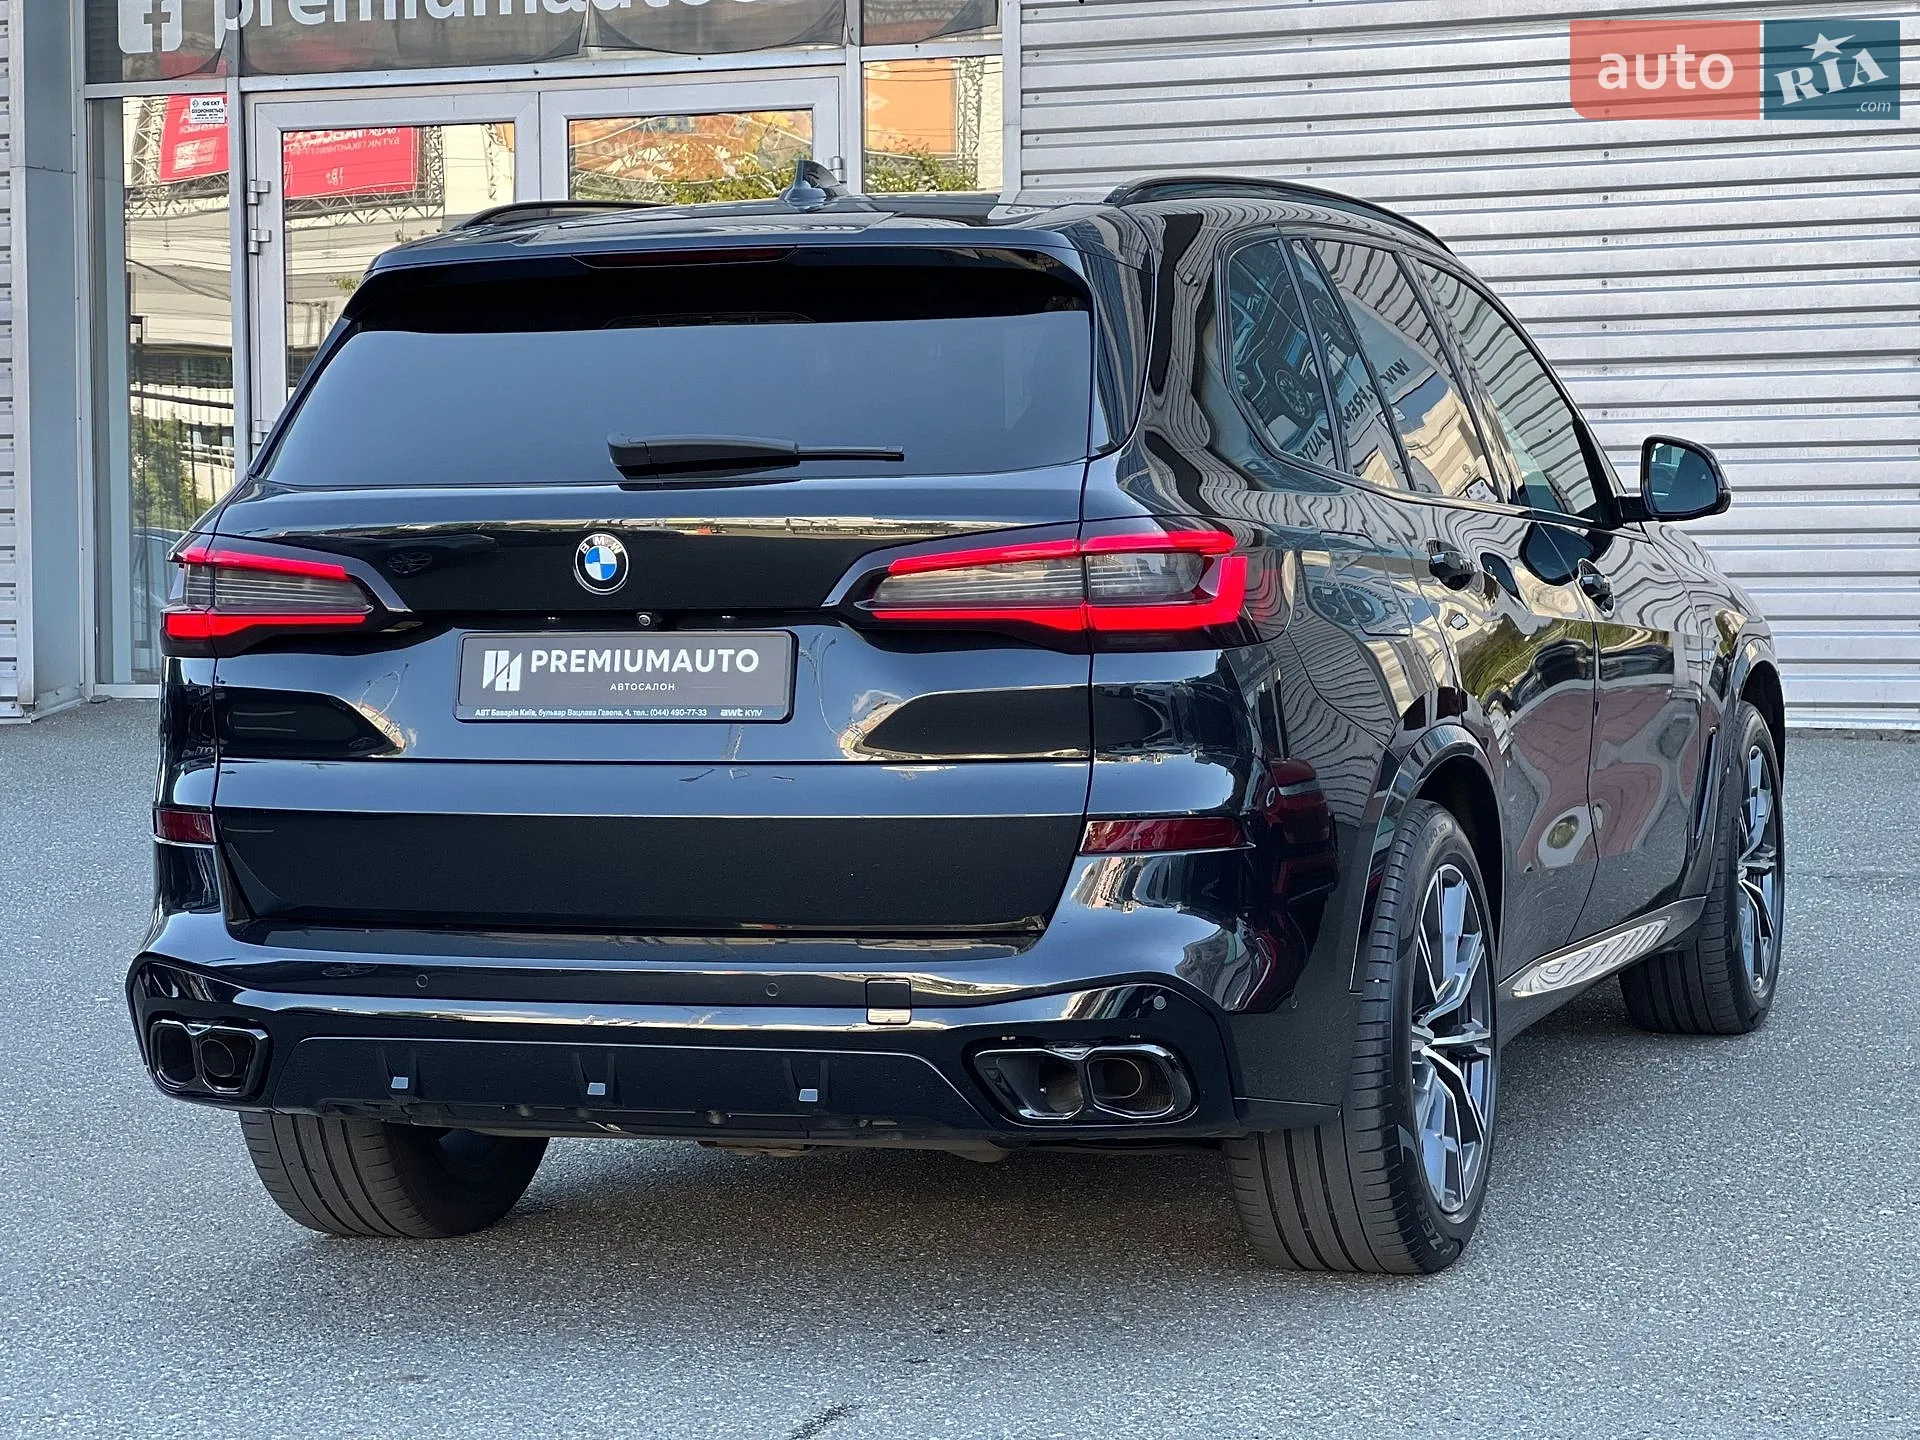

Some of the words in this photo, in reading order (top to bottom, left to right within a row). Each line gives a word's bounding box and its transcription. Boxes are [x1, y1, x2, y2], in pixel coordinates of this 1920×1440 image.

[579, 536, 623, 555] BMW
[530, 648, 759, 673] PREMIUMAUTO
[609, 682, 675, 691] АВТОСАЛОН
[650, 708, 669, 717] (044)
[670, 708, 708, 717] 490-77-33
[745, 709, 763, 717] KYIV
